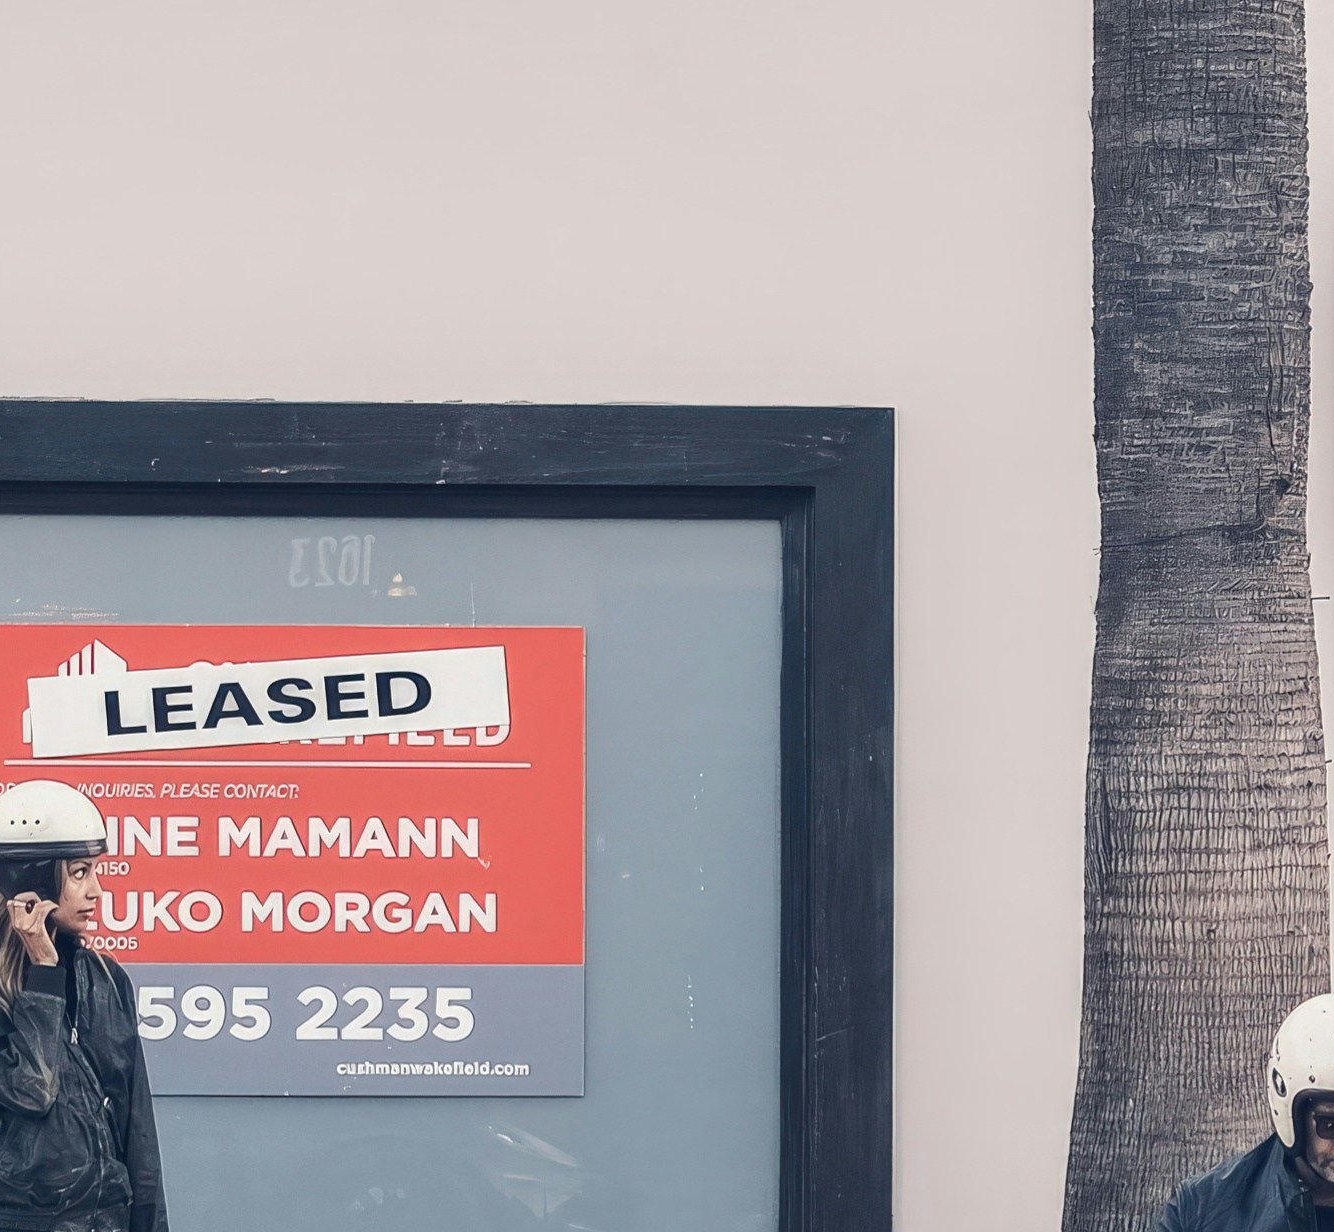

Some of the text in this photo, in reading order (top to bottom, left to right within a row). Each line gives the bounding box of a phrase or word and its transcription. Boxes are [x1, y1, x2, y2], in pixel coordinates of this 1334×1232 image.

[104, 669, 433, 737] LEASED
[159, 783, 221, 799] PLEASE
[106, 816, 480, 858] INE MAMANN
[86, 891, 498, 933] UKO MORGAN
[138, 985, 476, 1041] 595 2235
